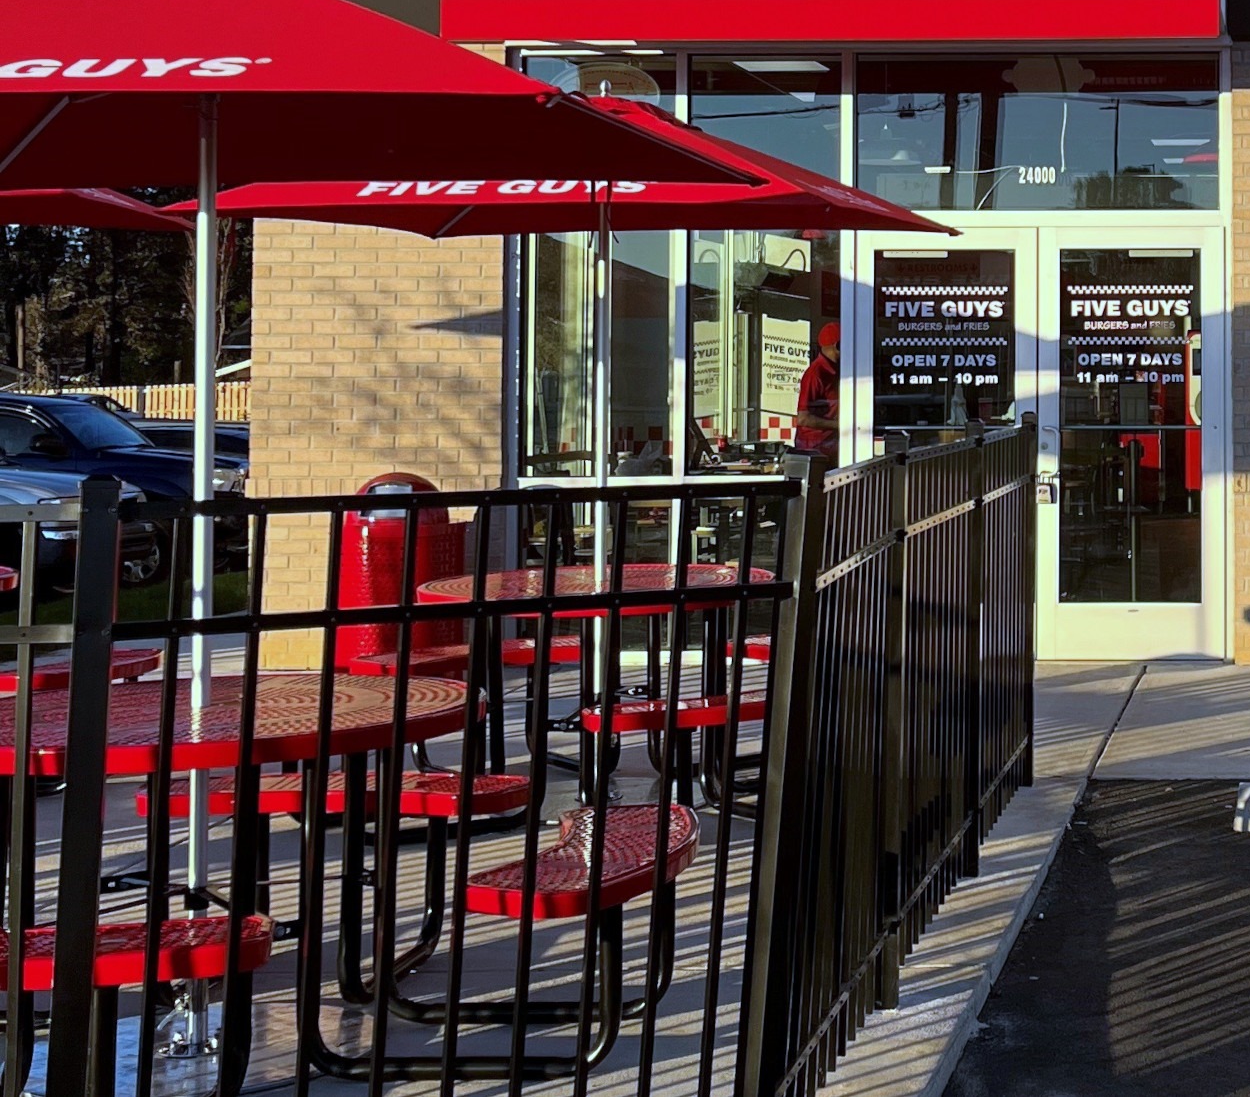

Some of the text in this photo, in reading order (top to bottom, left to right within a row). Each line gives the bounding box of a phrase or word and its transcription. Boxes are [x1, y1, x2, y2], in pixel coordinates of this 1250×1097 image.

[0, 57, 252, 78] GUYS
[1019, 166, 1056, 184] 24000
[356, 179, 647, 197] FIVE GUYS
[885, 301, 1004, 317] FIVE GUYS
[1071, 300, 1190, 317] FIVE GUYS
[898, 322, 990, 331] BURGERS and FRIES
[1084, 320, 1176, 330] BURGERS and FRIES
[764, 343, 786, 354] FIVE
[892, 354, 997, 367] OPEN 7 DAYS
[1078, 353, 1183, 365] OPEN 7 DAYS
[890, 373, 904, 384] 11
[909, 375, 932, 384] am
[955, 373, 973, 385] 10
[975, 374, 999, 386] pm
[1077, 372, 1091, 383] 11
[1096, 374, 1118, 383] am
[1142, 372, 1158, 383] 10
[1161, 373, 1184, 384] pm
